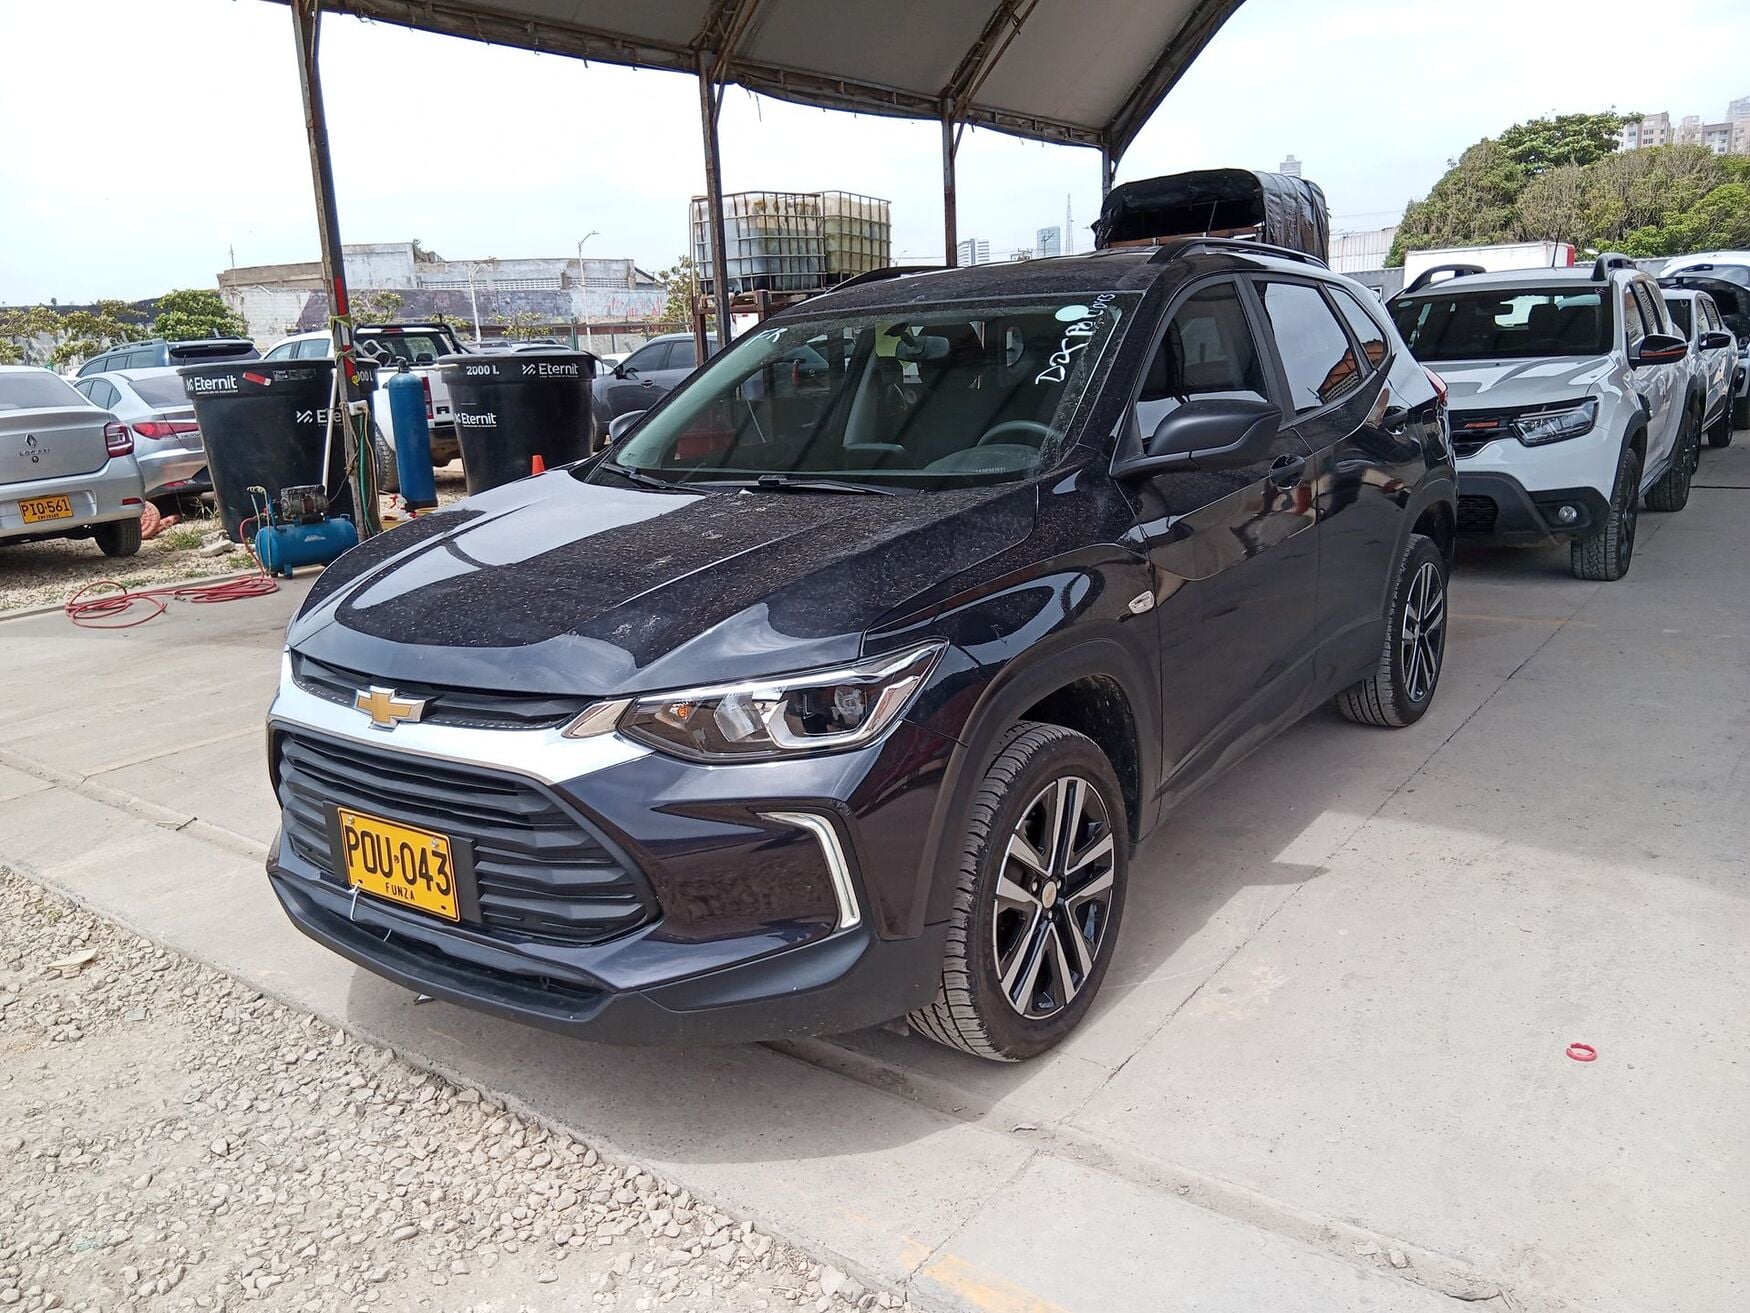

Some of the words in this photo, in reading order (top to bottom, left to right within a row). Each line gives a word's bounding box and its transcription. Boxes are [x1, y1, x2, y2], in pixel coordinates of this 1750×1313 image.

[466, 365, 490, 375] 2000
[539, 363, 579, 375] Eternit
[195, 375, 238, 392] Eternit
[461, 412, 497, 425] Eternit
[385, 882, 416, 901] FUNZA
